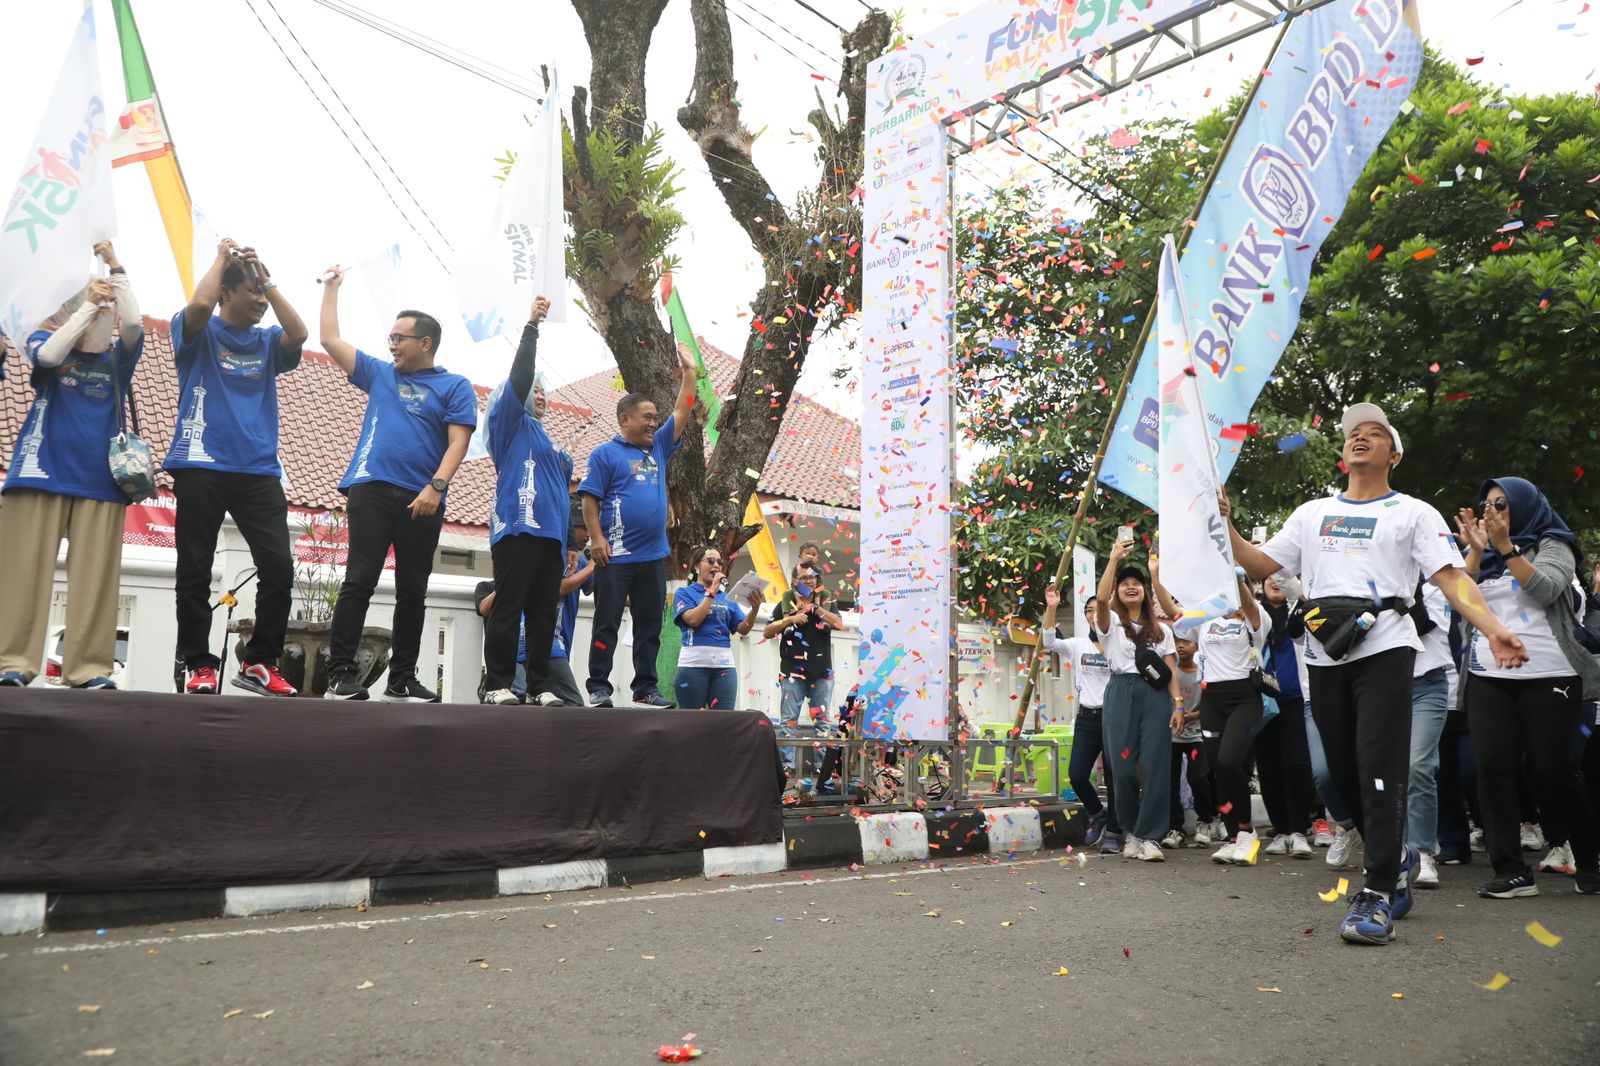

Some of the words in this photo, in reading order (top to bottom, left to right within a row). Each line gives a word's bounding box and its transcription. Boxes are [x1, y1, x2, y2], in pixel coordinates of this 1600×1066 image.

[985, 8, 1057, 63] FUN
[1196, 223, 1282, 378] BANK
[1286, 41, 1361, 166] BPD
[866, 257, 886, 271] BANK
[920, 240, 935, 253] DIY
[1331, 524, 1349, 534] Bank
[964, 648, 992, 656] TEKWN
